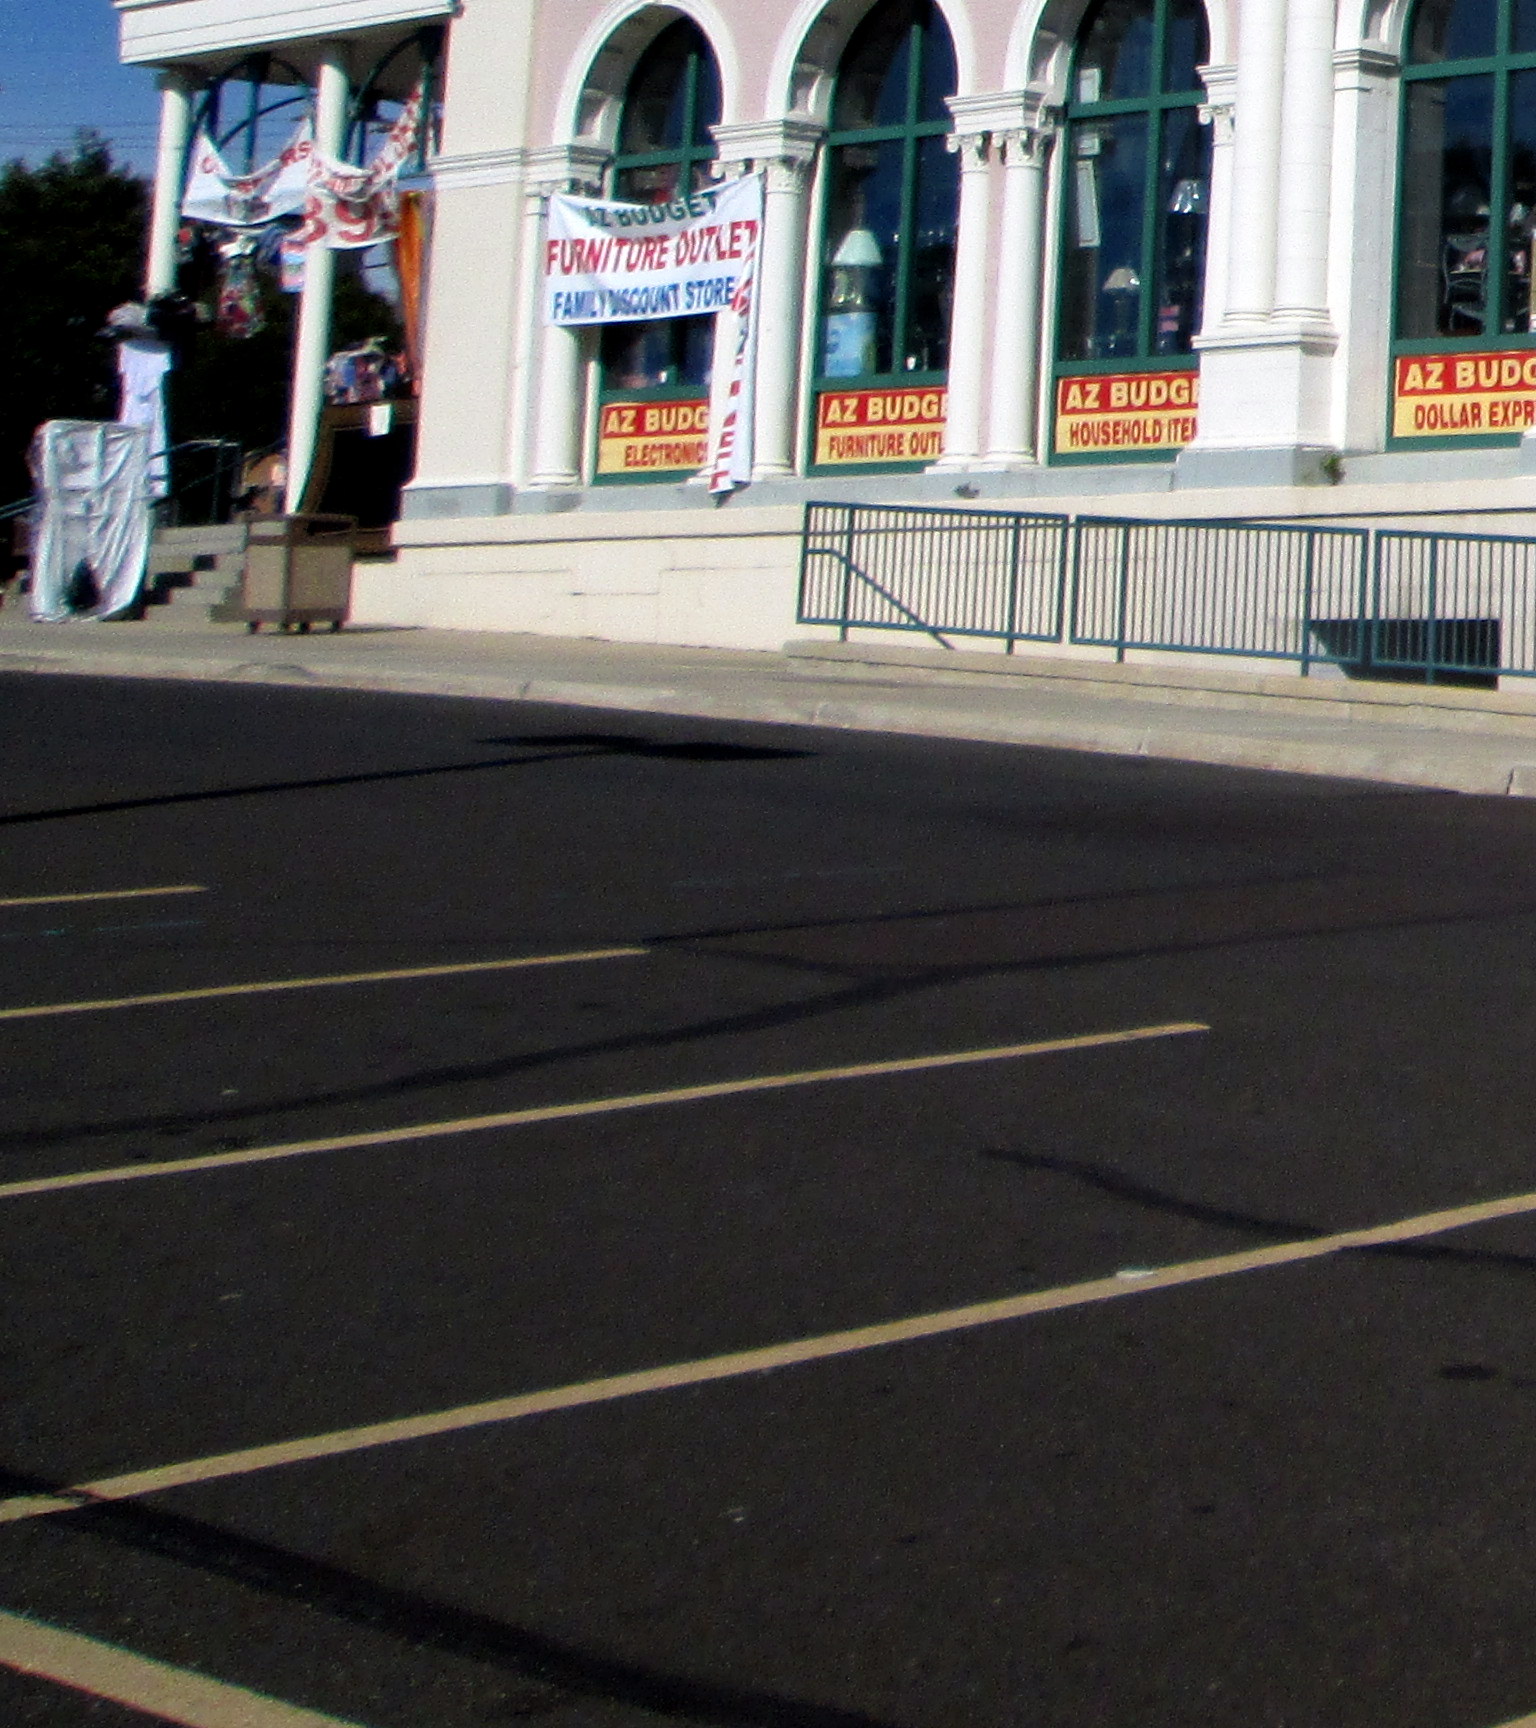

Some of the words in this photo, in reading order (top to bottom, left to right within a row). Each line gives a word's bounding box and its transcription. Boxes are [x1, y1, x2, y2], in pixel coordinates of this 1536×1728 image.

[617, 191, 717, 227] BUDGET
[545, 234, 670, 275] FURNITURE
[676, 220, 759, 266] OUTLET
[553, 288, 606, 319] FAMILY
[609, 283, 680, 316] DISCOUNT
[1404, 362, 1446, 390] AZ
[1066, 382, 1101, 410] AZ
[606, 409, 638, 434] AZ
[826, 398, 859, 424] AZ
[1414, 401, 1482, 430] DOLLAR
[830, 433, 904, 459] FURNITURE
[1070, 419, 1163, 447] HOUSEHOLD
[625, 442, 709, 467] ELECTRONIC
